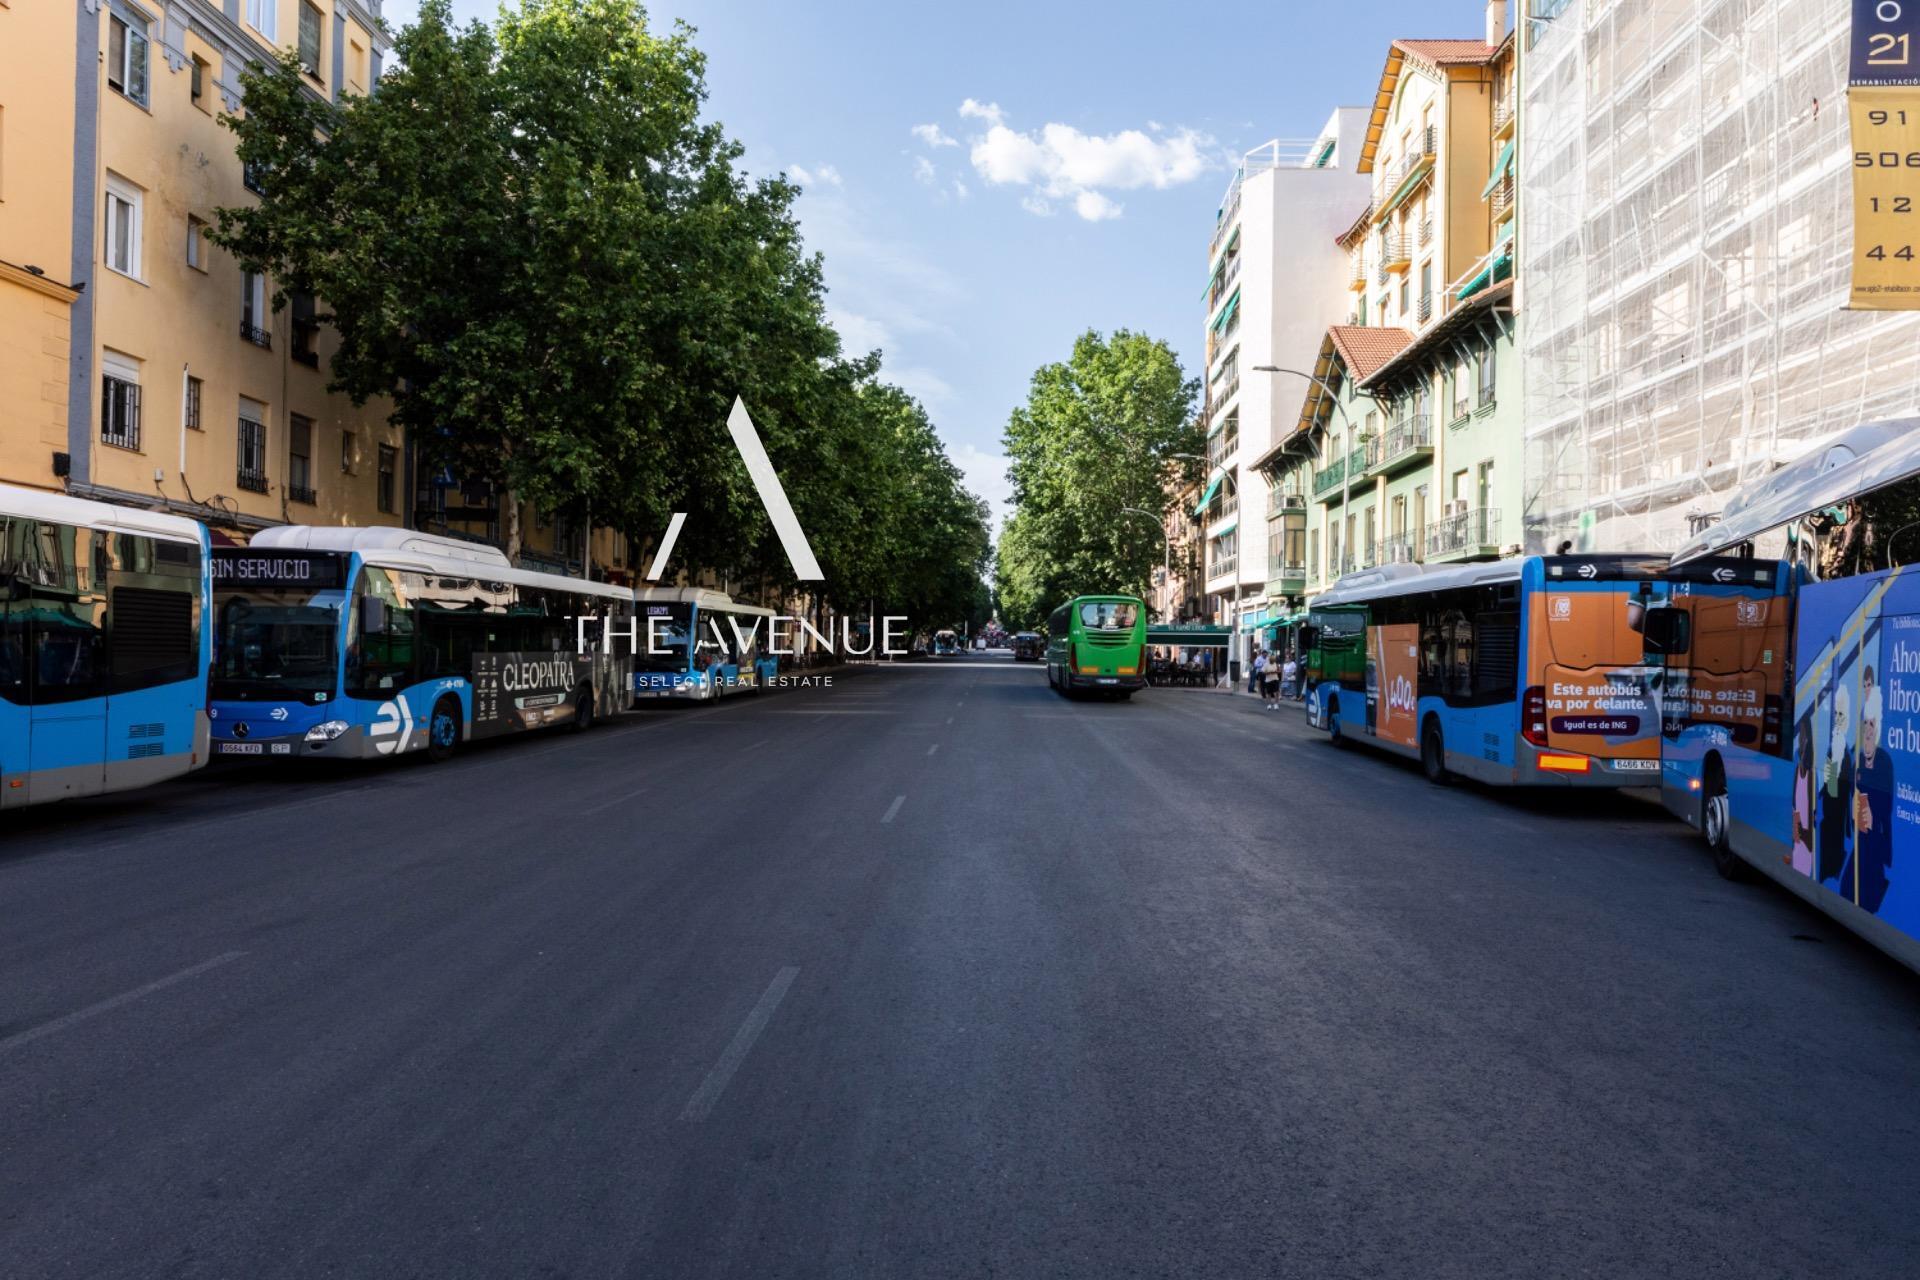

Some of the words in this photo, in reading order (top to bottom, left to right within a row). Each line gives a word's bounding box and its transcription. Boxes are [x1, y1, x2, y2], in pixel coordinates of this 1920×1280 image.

[1876, 1, 1902, 23] O
[1867, 33, 1910, 65] 21
[237, 559, 310, 579] SERVICIO
[503, 651, 575, 692] CLEOPATRA
[1553, 683, 1583, 696] Este
[1587, 682, 1641, 696] autobús
[1547, 700, 1562, 709] va
[1566, 700, 1589, 712] por
[1594, 697, 1648, 710] delante.
[1564, 720, 1585, 731] Igual
[1599, 720, 1610, 729] de
[1611, 721, 1627, 729] ING
[1888, 726, 1904, 749] en
